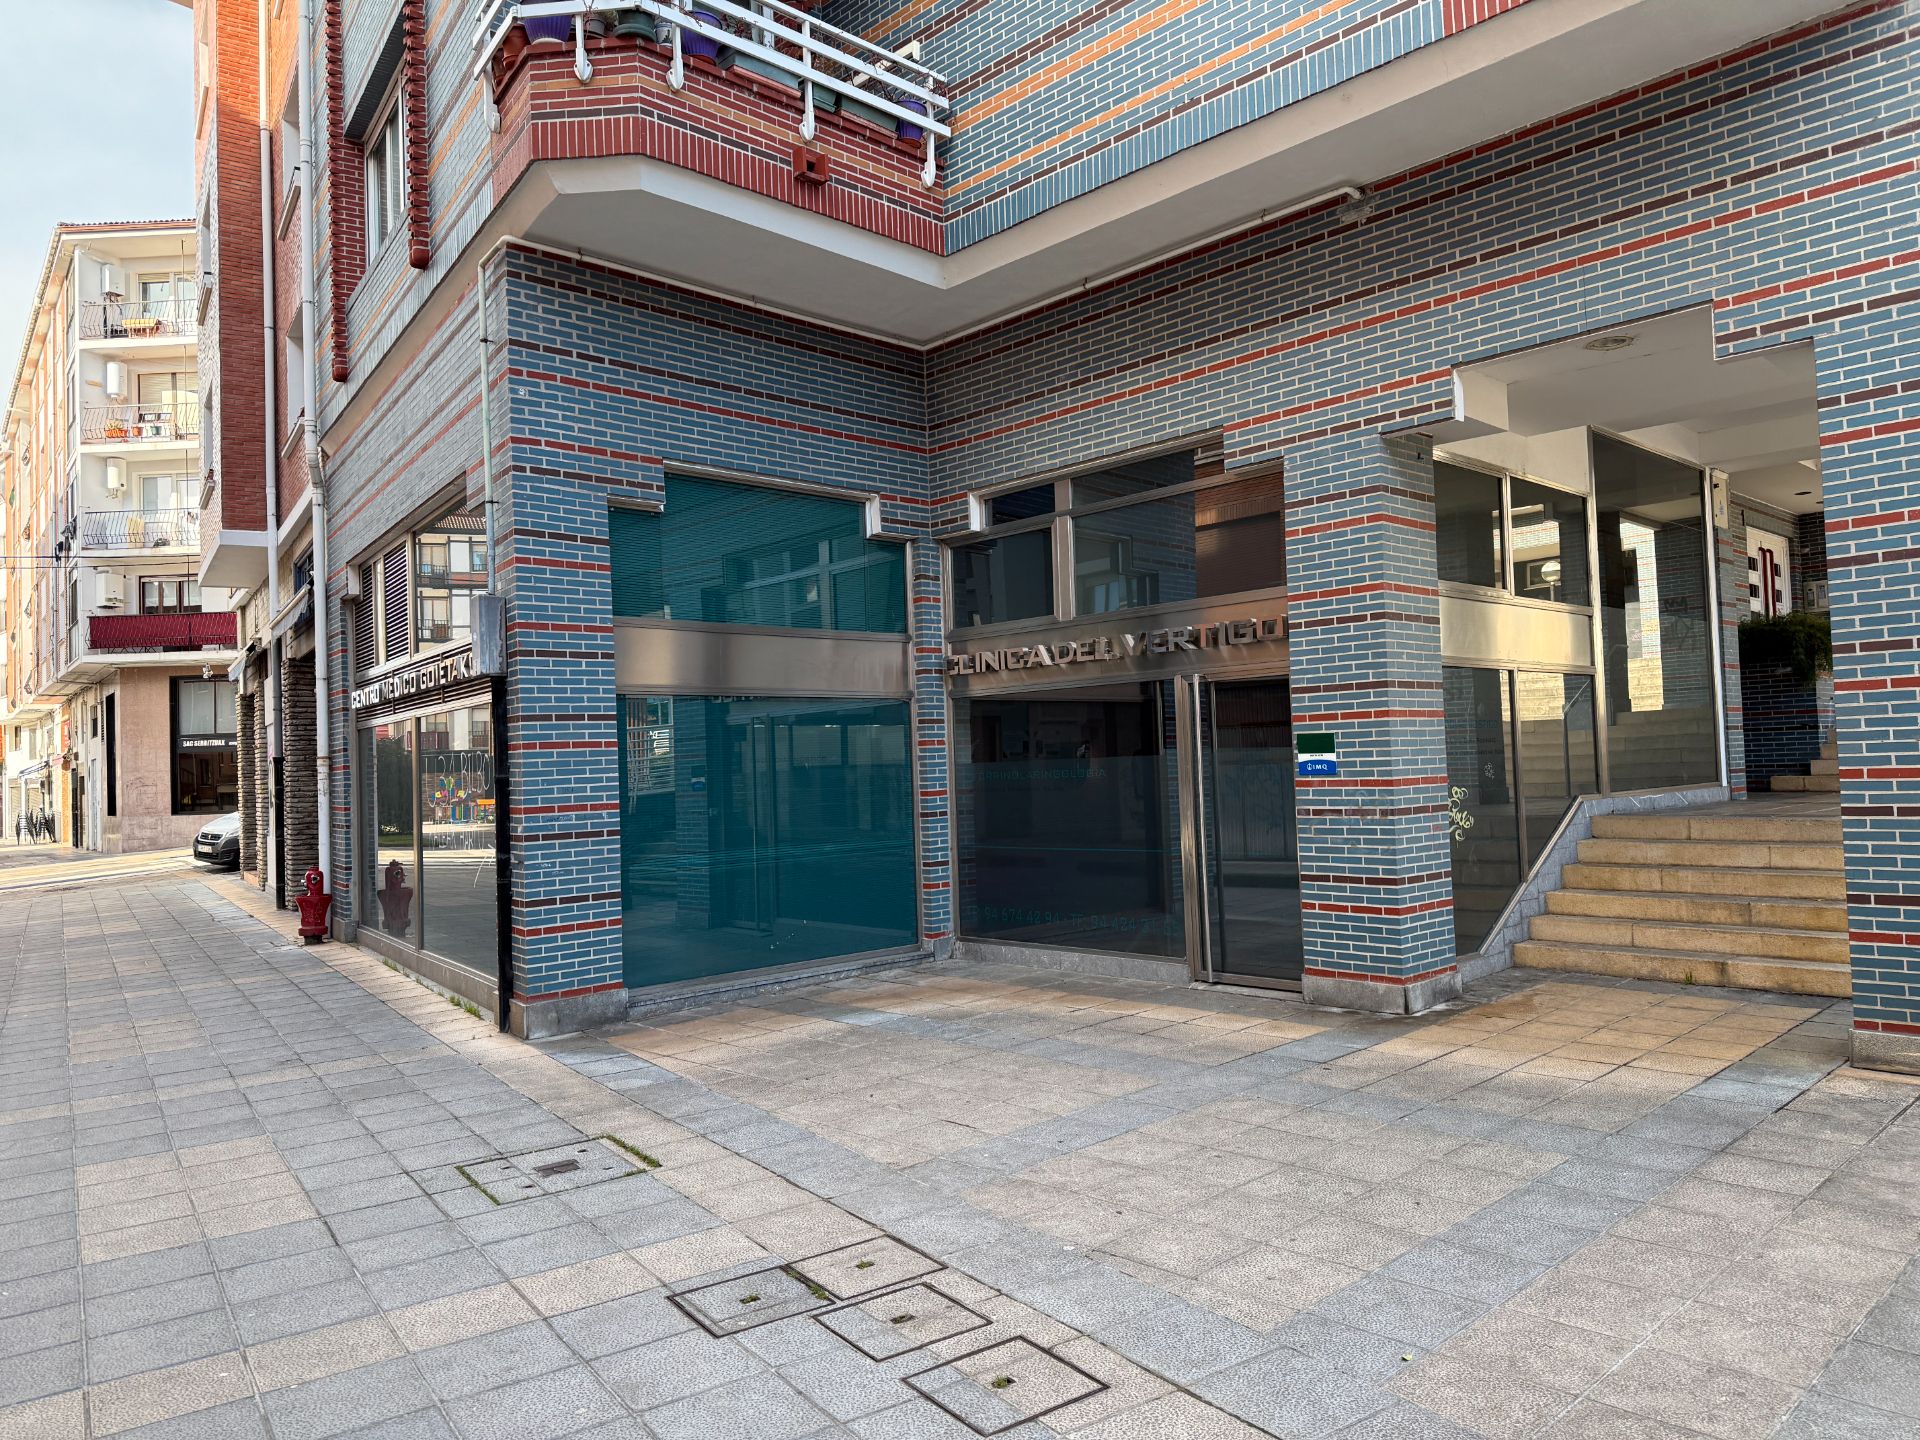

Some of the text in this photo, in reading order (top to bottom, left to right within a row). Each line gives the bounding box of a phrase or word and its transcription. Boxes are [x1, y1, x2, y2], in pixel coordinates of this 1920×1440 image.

[945, 614, 1287, 676] CLINICA DEL VERTIGO
[351, 684, 380, 709] CENTRO
[381, 671, 417, 700] MEDICO
